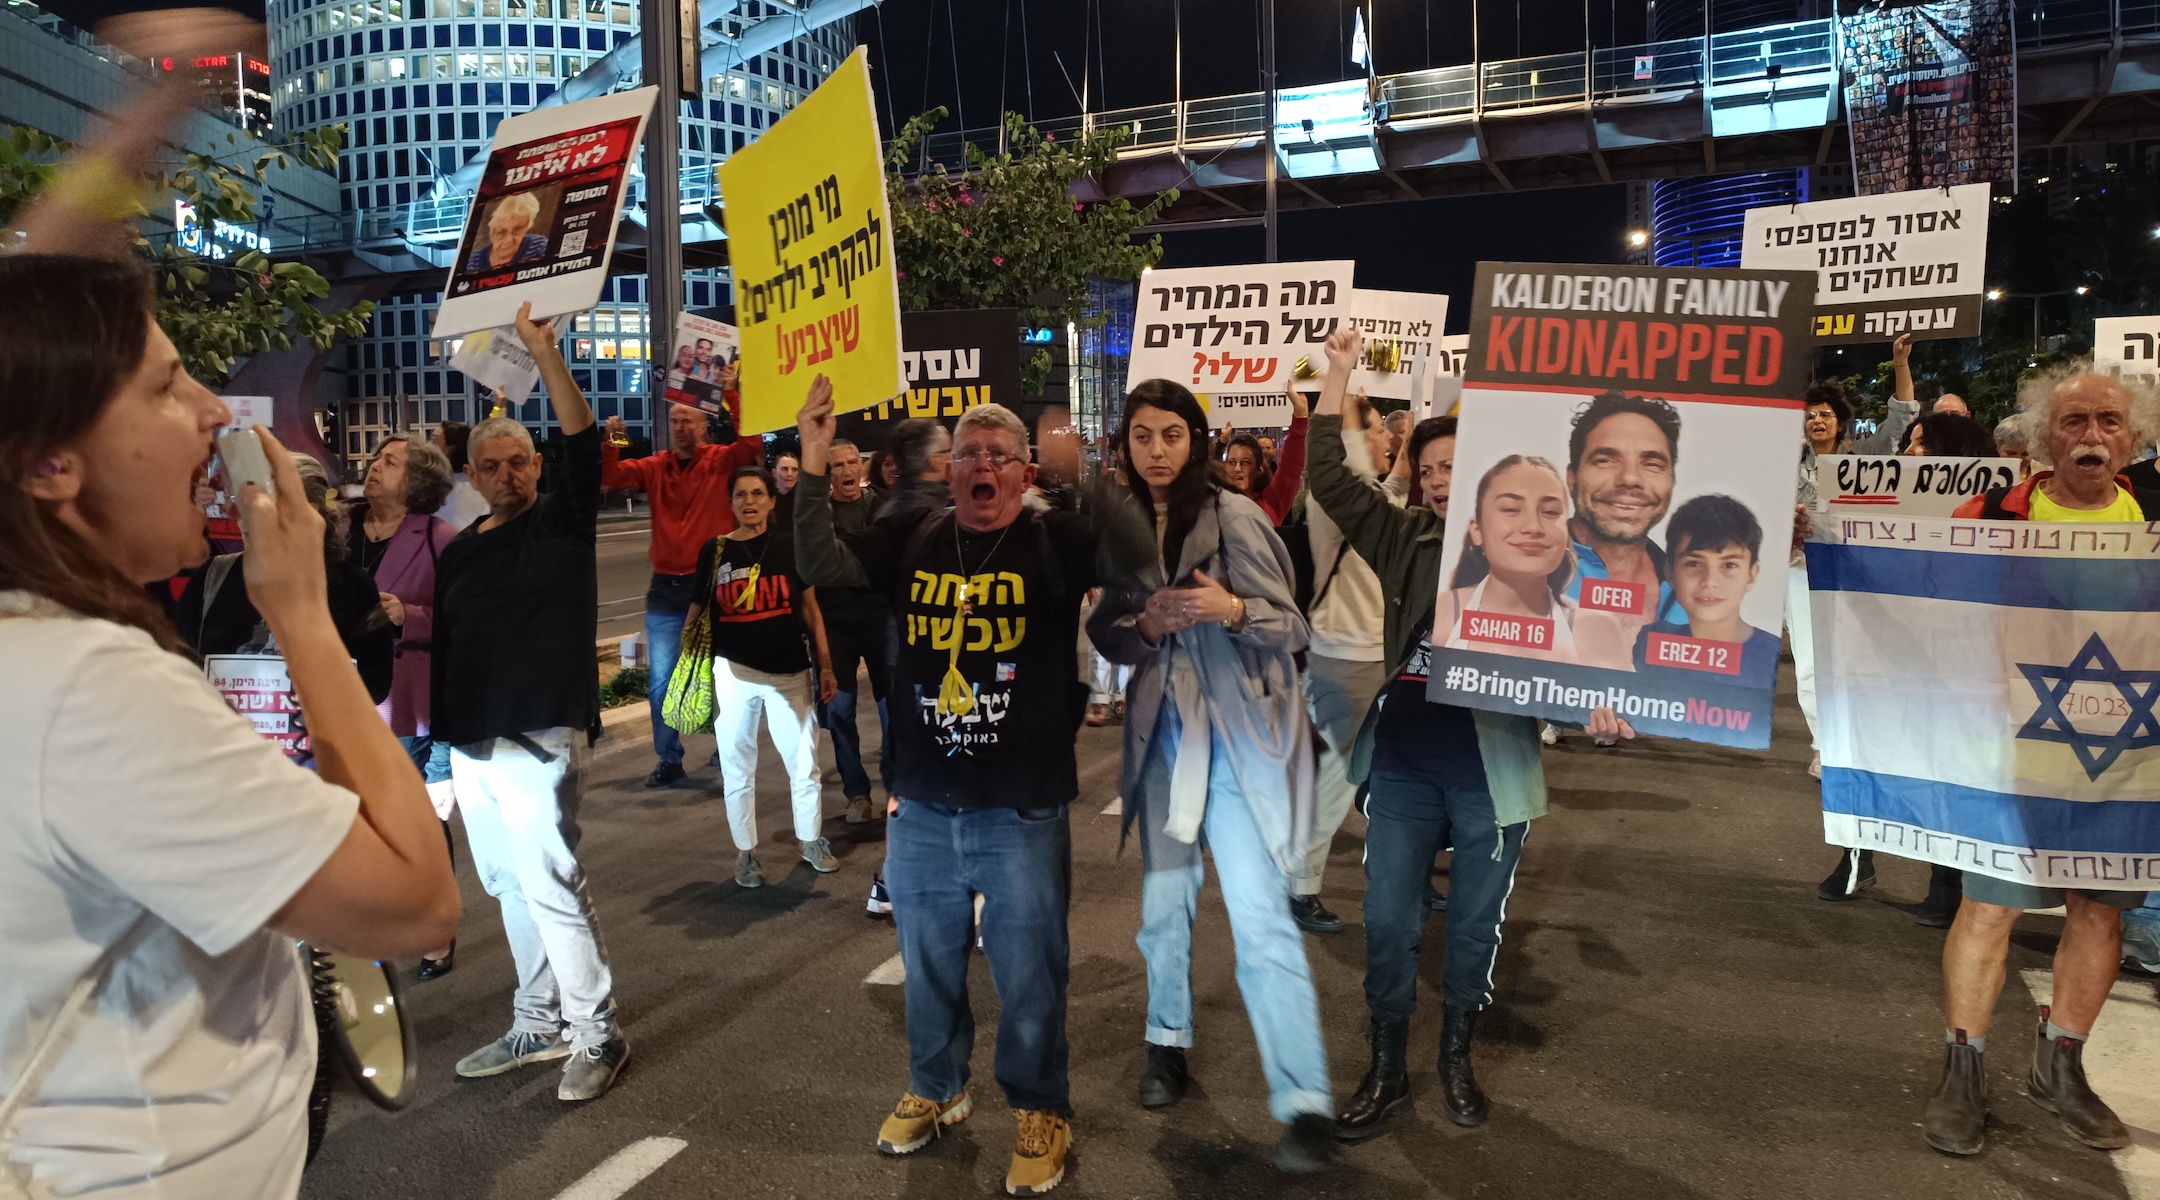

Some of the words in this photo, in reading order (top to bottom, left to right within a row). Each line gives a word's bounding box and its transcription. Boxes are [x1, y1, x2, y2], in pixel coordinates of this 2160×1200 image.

[502, 154, 570, 186] איתנו
[571, 142, 609, 169] לא
[815, 174, 842, 224] מי
[769, 193, 815, 266] מוכן
[1765, 214, 1876, 248] לפספס!
[1886, 208, 1961, 236] אסור
[550, 255, 592, 274] החזירו
[809, 208, 881, 300] להקריב
[1818, 241, 1897, 268] אנחנו
[515, 264, 550, 282] אותם
[1829, 262, 1959, 294] משחקים
[740, 259, 806, 327] ילדים?
[1151, 283, 1269, 311] המחיר
[1280, 280, 1336, 307] מה
[1490, 272, 1659, 314] KALDERON
[1664, 277, 1790, 318] FAMILY
[1143, 315, 1270, 348] הילדים
[1281, 312, 1339, 344] של
[1407, 320, 1432, 337] לא
[1864, 307, 1957, 337] עסקה
[776, 303, 860, 376] שיצביע!
[1485, 315, 1784, 386] KIDNAPPED
[1192, 351, 1278, 385] שלי?
[1218, 395, 1287, 408] החטופים!
[1837, 458, 1901, 495] בראש
[1913, 459, 2013, 496] החטופים
[716, 574, 790, 615] NOW!
[1591, 585, 1633, 608] OFER
[907, 613, 1026, 653] עכשיו
[1469, 617, 1521, 642] SAHAR
[1526, 624, 1545, 644] 16
[1658, 640, 1702, 665] EREZ
[1707, 647, 1728, 668] 12
[213, 678, 226, 687] 84
[1445, 665, 1751, 732] #BringThemHomeNow
[280, 695, 302, 711] א
[276, 721, 286, 730] 84
